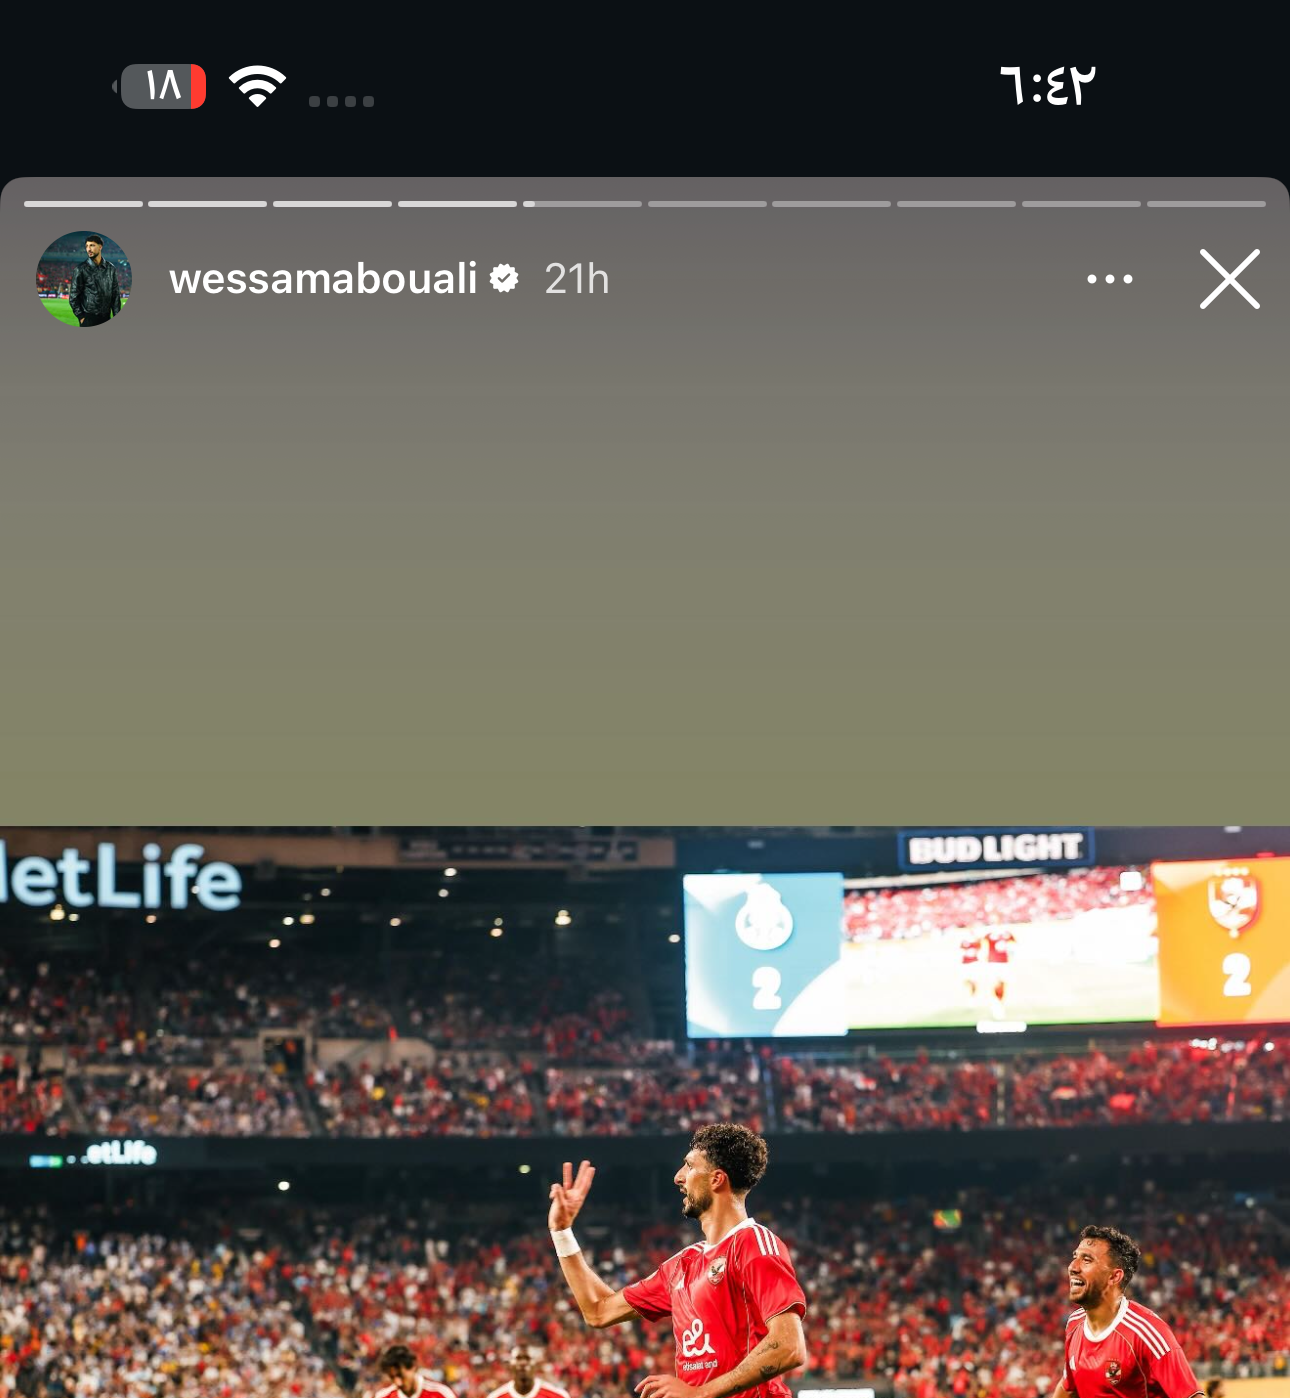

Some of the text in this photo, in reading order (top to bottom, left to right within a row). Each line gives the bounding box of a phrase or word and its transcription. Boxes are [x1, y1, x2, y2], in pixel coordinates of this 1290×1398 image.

[909, 833, 1083, 864] BUD LIGHT
[0, 839, 242, 910] etLife
[752, 966, 782, 1010] 2
[1222, 952, 1252, 997] 2
